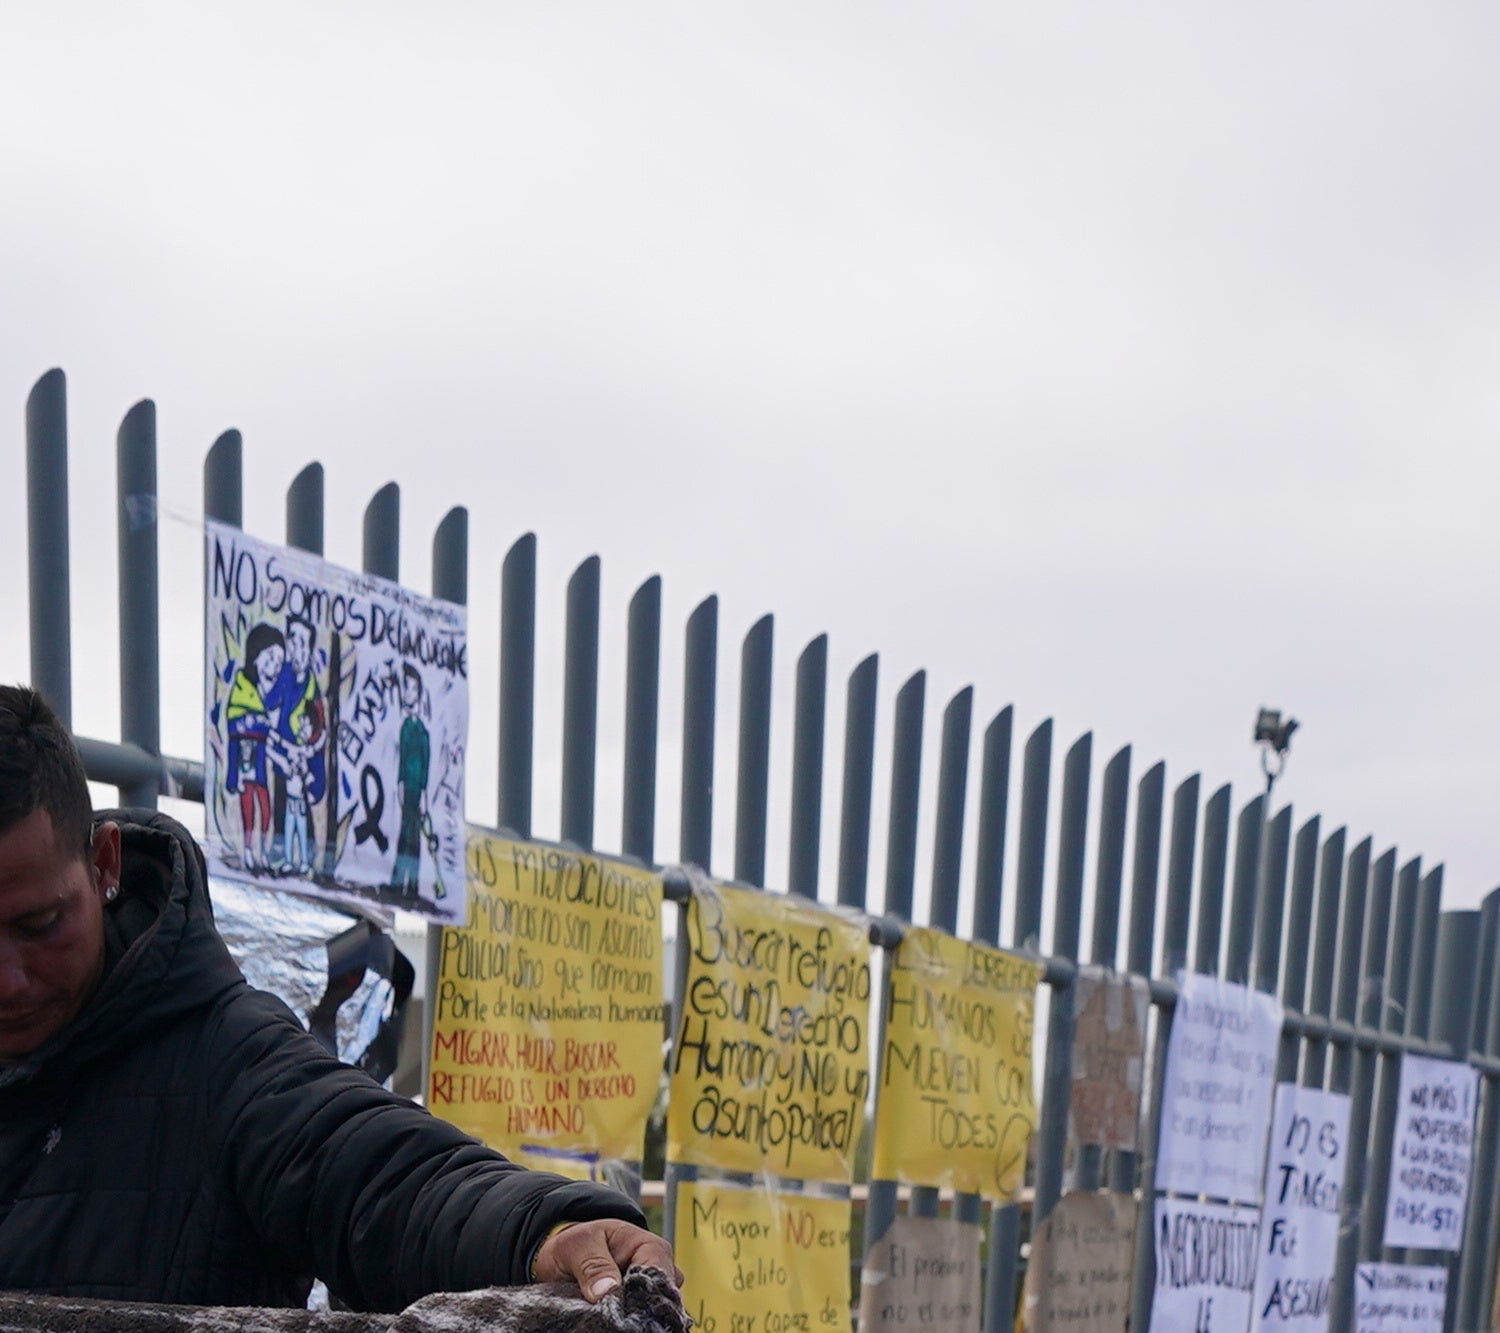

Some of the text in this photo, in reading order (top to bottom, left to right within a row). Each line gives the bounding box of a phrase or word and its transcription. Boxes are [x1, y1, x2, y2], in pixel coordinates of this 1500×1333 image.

[214, 536, 257, 606] NO
[786, 926, 872, 1010] refugio
[563, 1037, 621, 1074] BUSCAR
[886, 1040, 982, 1096] MUEVEN
[430, 1071, 636, 1106] REFUGIO ES UN DERECHO
[507, 1104, 585, 1136] HUMANO
[921, 1094, 999, 1151] TODES
[691, 1196, 772, 1261] Migrar
[784, 1206, 816, 1250] NO
[731, 1256, 789, 1292] delito
[819, 1297, 840, 1327] de
